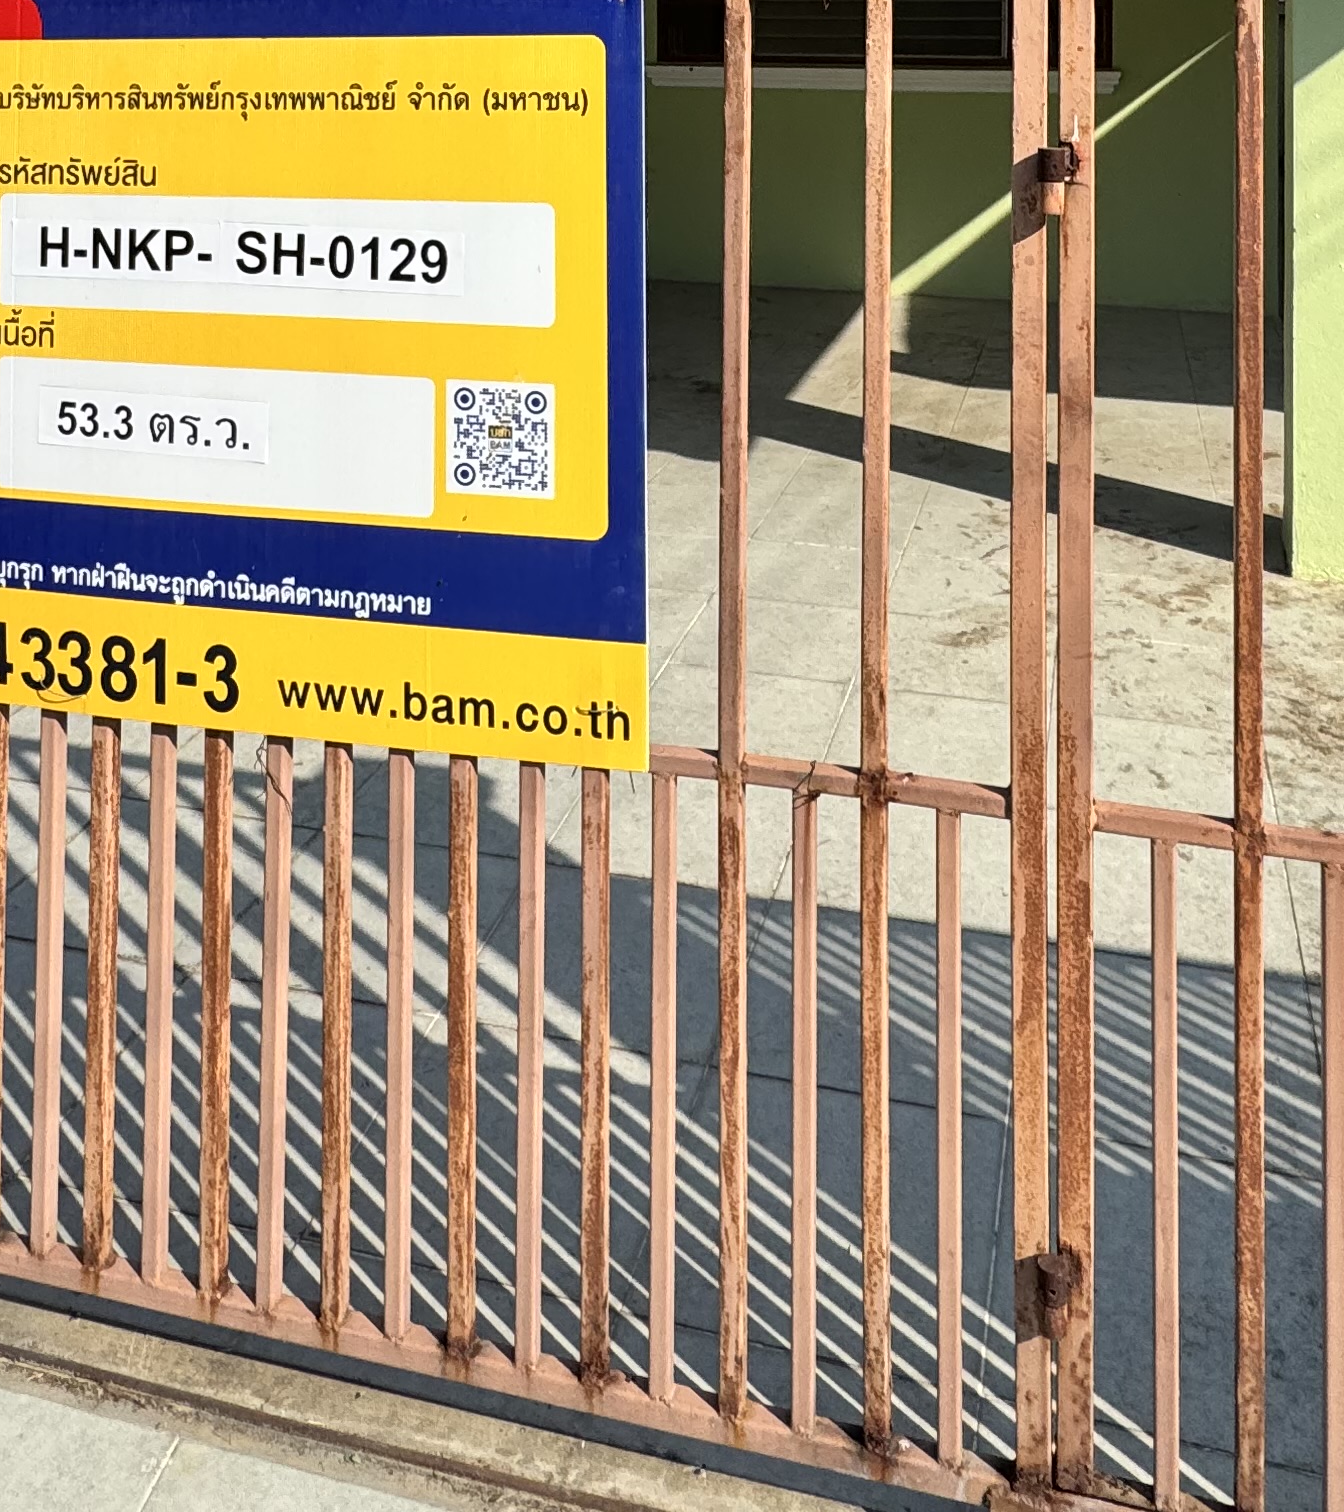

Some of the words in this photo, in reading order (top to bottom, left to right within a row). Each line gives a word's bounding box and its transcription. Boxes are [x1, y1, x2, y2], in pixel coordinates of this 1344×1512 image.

[408, 81, 470, 112] จำกัด
[482, 87, 589, 115] (มหาชน)
[39, 225, 212, 272] H-NKP-
[235, 230, 449, 285] SH-0129
[57, 400, 134, 441] 53.3
[149, 410, 251, 451] ตร.ว.
[51, 561, 432, 618] หากฝ่าฝืนจะถูกดำเนินคดีตามกฎหมาย
[278, 677, 631, 742] www.bam.co.th
